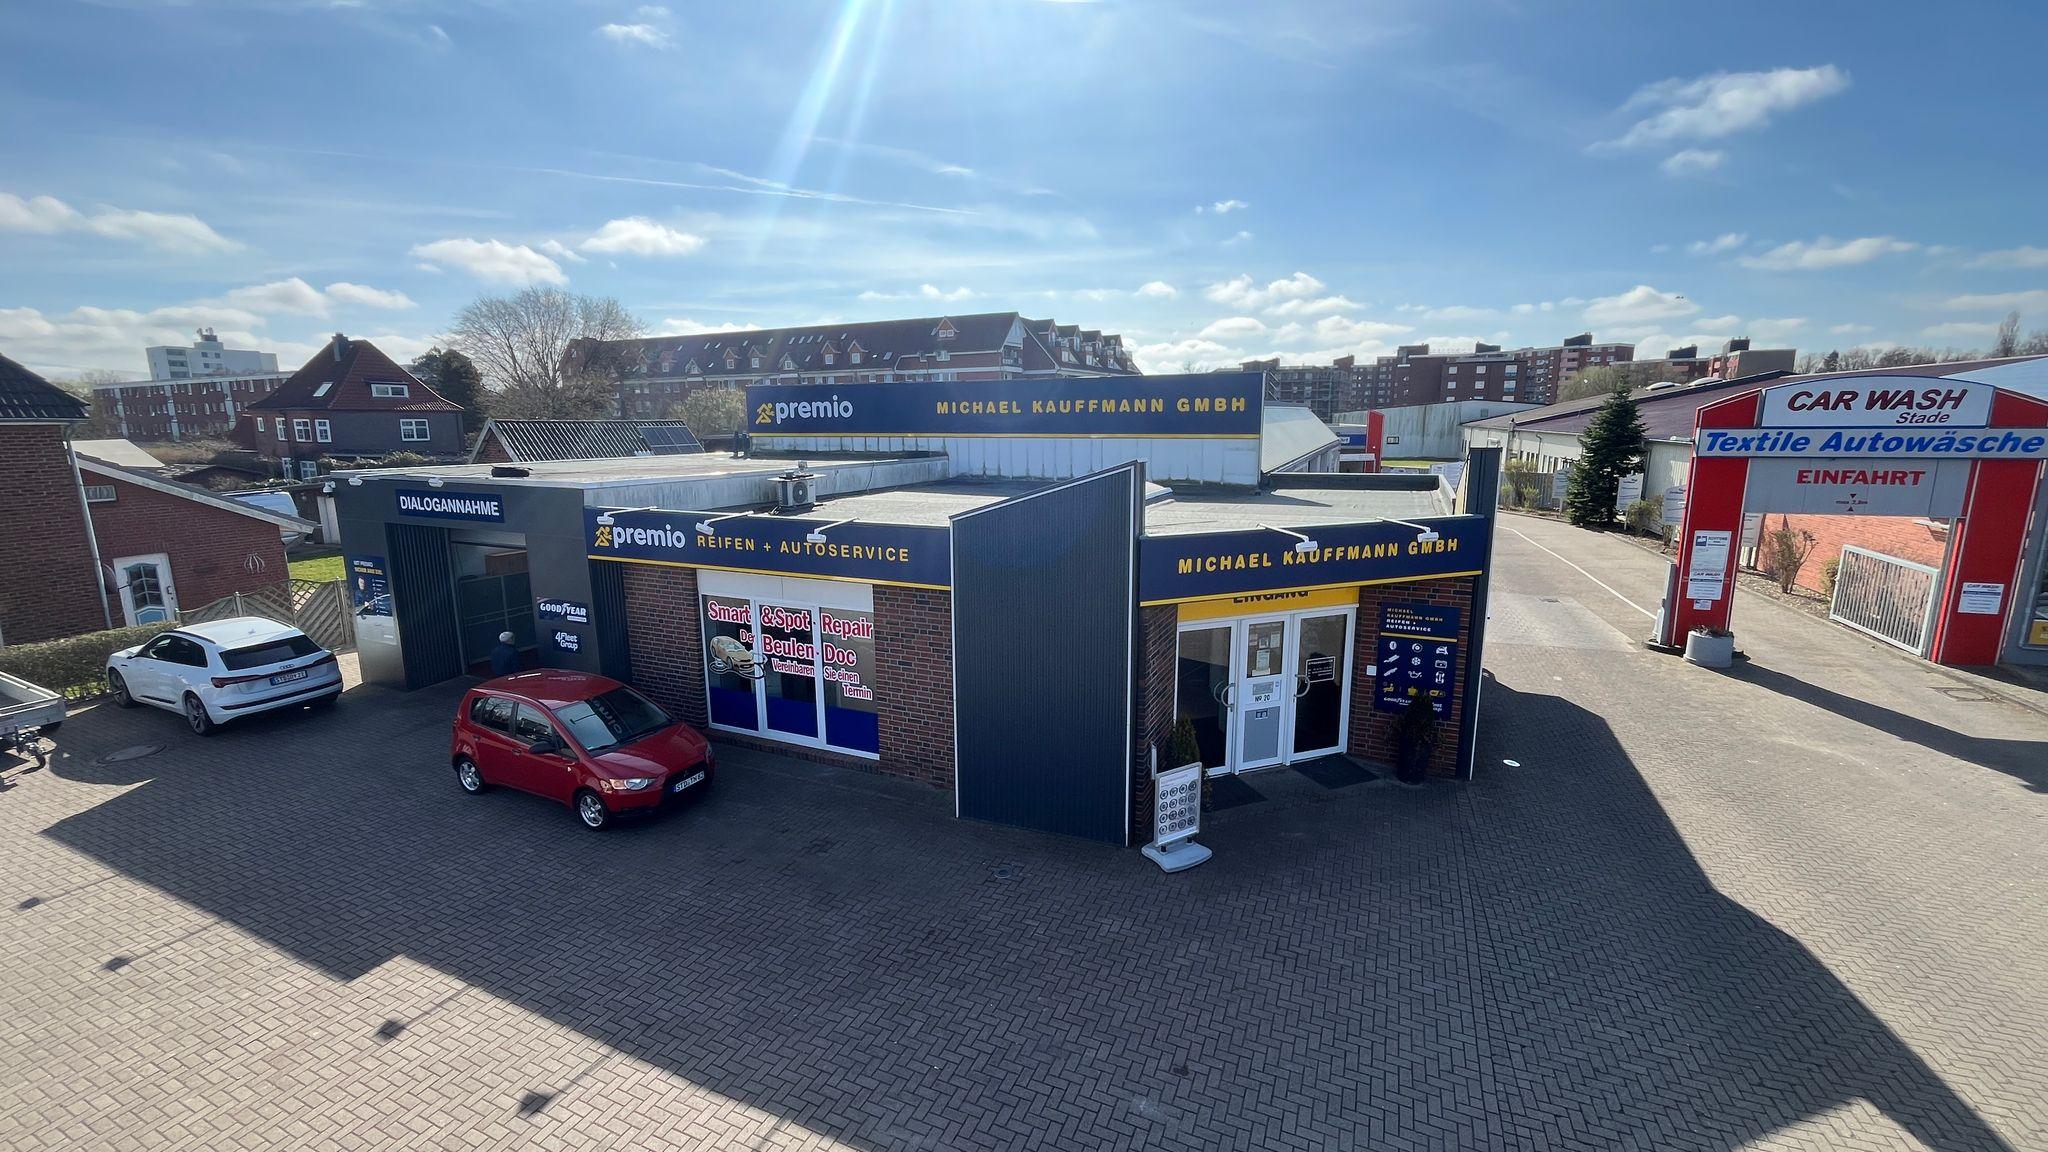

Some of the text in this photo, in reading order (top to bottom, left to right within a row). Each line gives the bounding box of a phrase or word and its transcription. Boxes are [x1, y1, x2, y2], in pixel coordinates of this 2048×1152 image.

[775, 394, 854, 424] premio
[936, 397, 1246, 414] MICHAEL KAUFFMANN GMBH
[1787, 388, 1968, 411] CAR WASH
[1895, 411, 1951, 425] Stade
[1705, 430, 2046, 454] Textile Autowäsche
[1796, 469, 1926, 486] EINFAHRT
[399, 495, 500, 516] DIALOGANNAHME
[612, 523, 686, 549] premio
[697, 535, 909, 562] REIFEN + AUTOSERVICE
[1178, 538, 1459, 575] MICHAEL KAUFFMANN GMBH
[540, 602, 587, 617] GOODYEAR
[707, 600, 752, 625] Smart
[820, 613, 873, 640] Repair
[1386, 624, 1432, 632] AUTOSERVICE
[560, 640, 579, 652] Group
[762, 634, 815, 660] Beulen
[824, 642, 857, 667] Doc
[771, 658, 860, 685] Vereinbaren Sie einen
[842, 683, 873, 701] Termin
